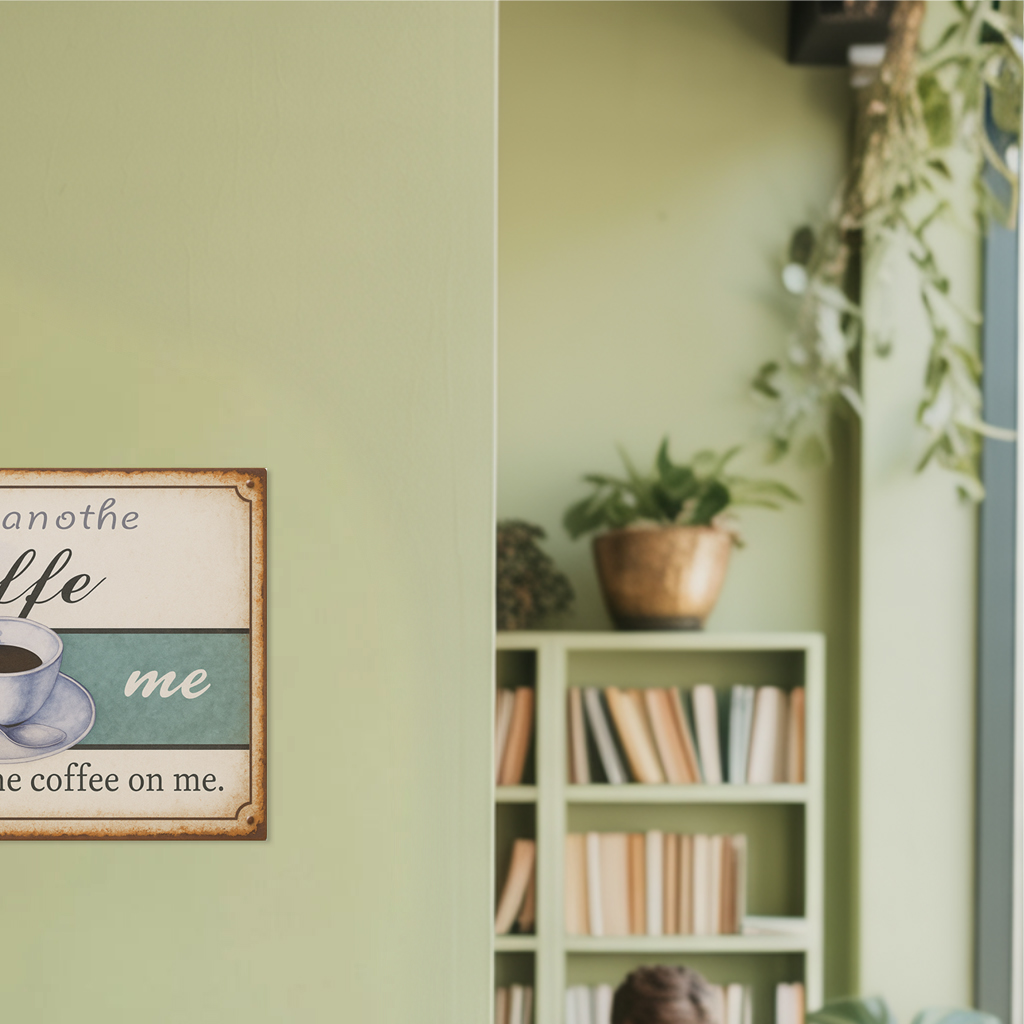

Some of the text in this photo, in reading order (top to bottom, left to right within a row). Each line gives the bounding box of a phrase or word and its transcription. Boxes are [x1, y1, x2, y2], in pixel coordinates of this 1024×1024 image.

[2, 497, 139, 531] anothe
[124, 667, 211, 700] me
[30, 762, 119, 793] coffee
[128, 771, 164, 793] on
[173, 771, 225, 793] me.
